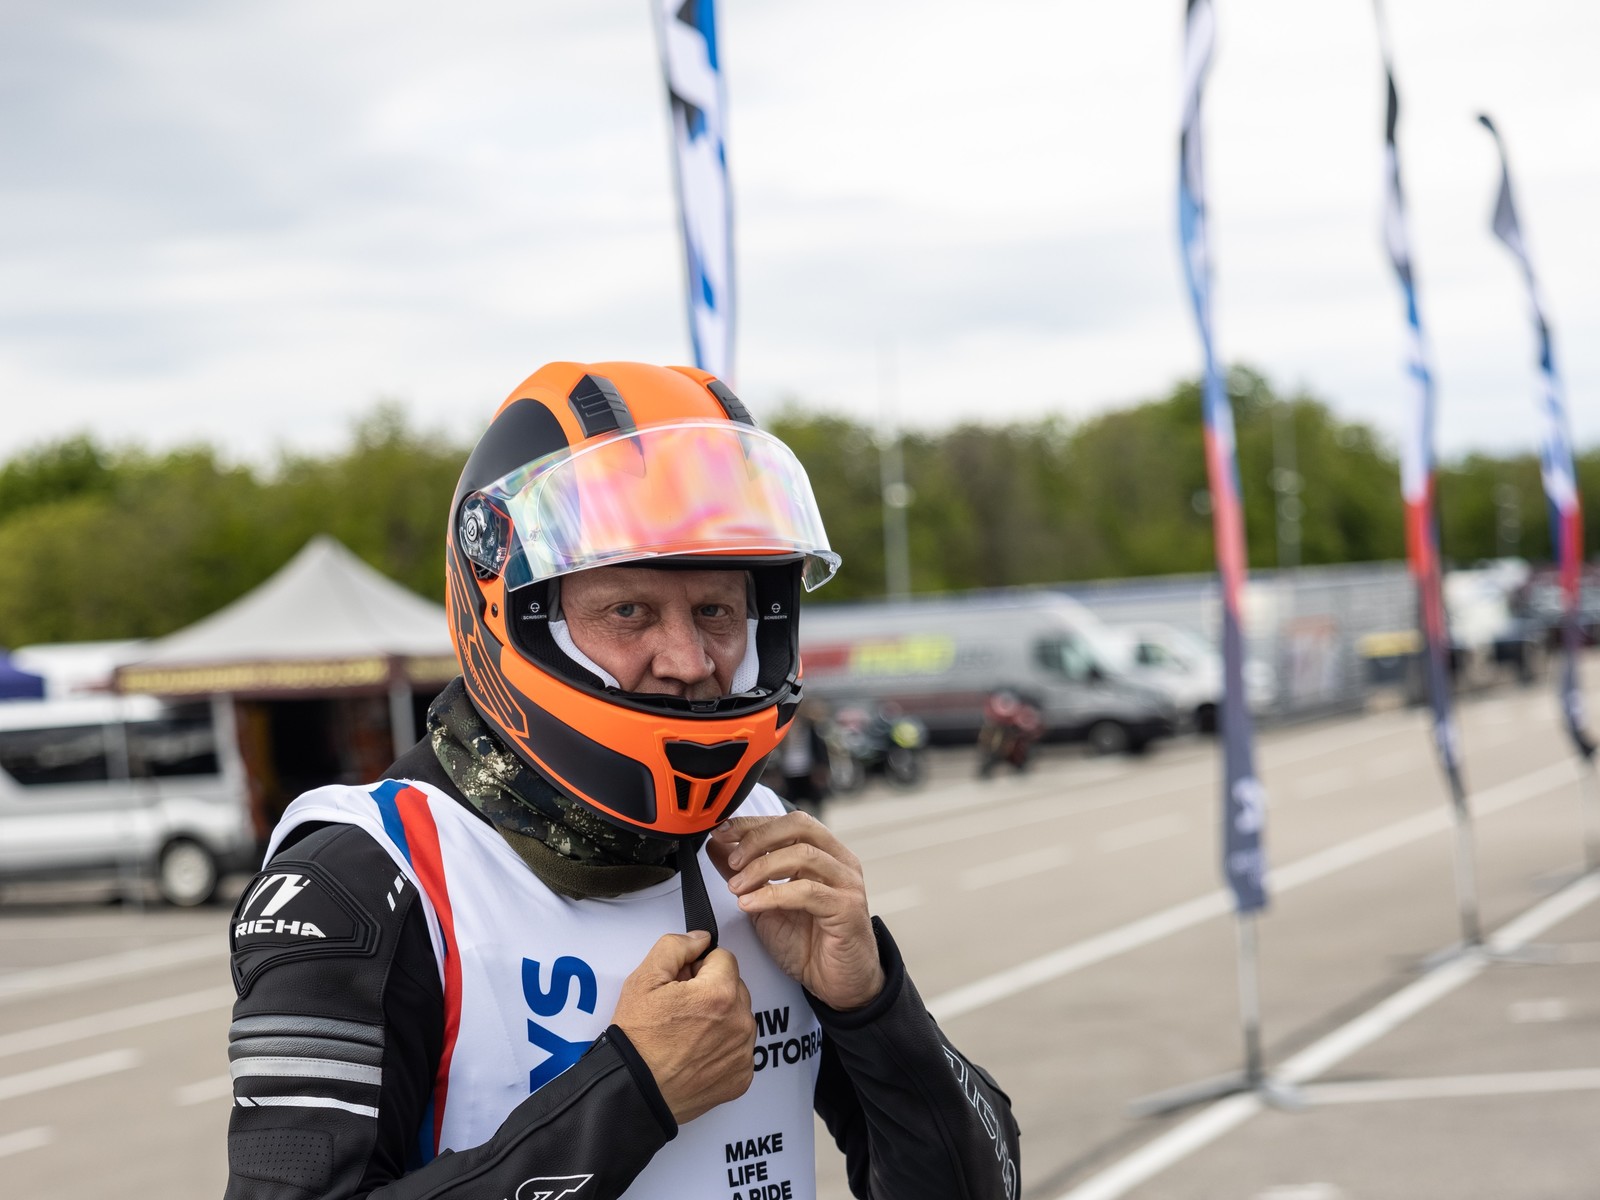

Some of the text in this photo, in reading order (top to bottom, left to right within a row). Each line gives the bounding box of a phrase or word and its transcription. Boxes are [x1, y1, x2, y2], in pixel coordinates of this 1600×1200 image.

[235, 919, 327, 938] RICHA
[753, 1027, 823, 1072] OTORRA
[725, 1132, 783, 1164] MAKE
[727, 1160, 768, 1188] LIFE
